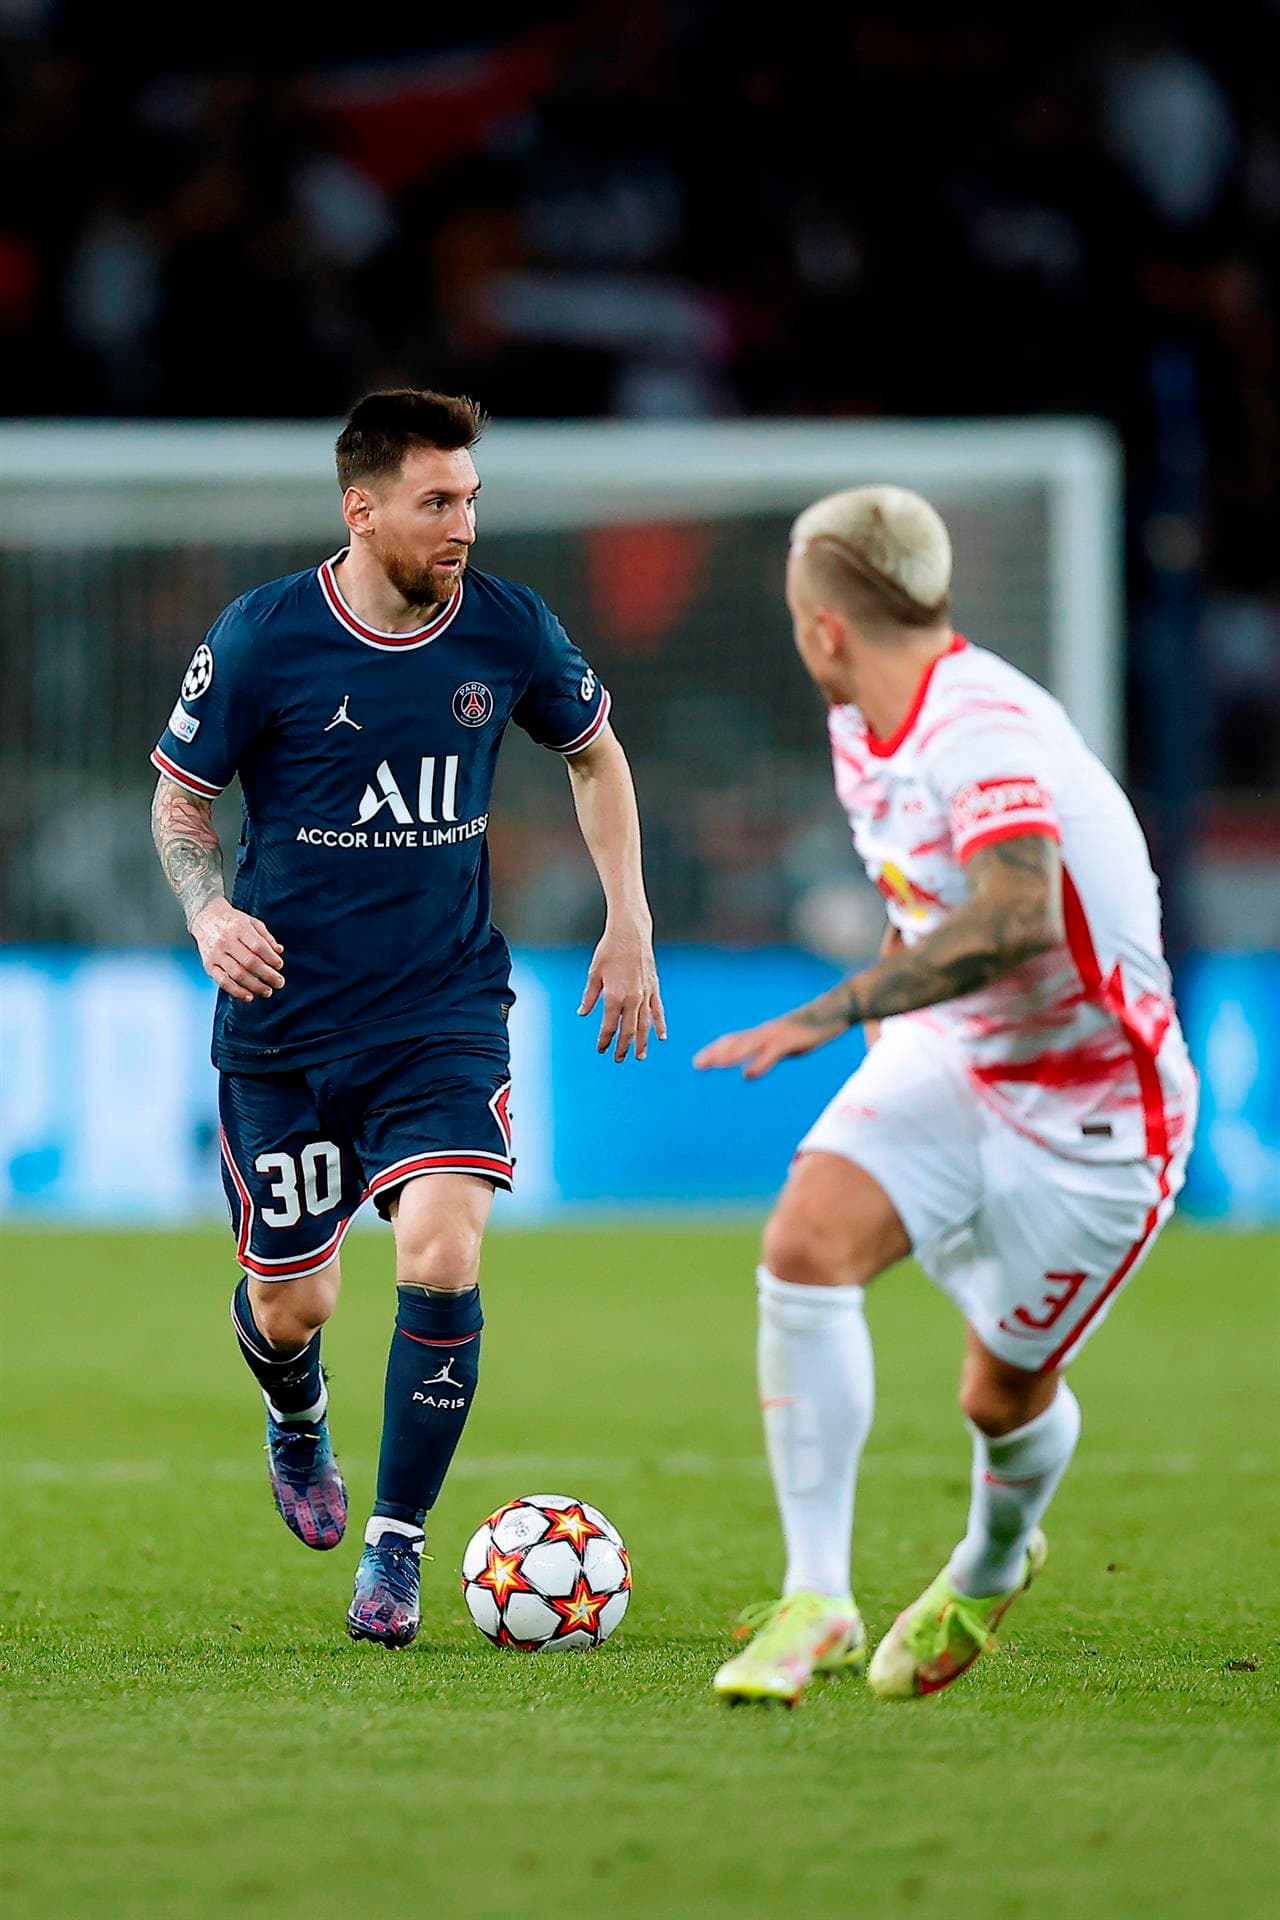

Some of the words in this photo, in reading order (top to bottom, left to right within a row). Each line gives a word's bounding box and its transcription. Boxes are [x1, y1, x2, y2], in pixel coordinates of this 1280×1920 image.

[459, 684, 487, 696] PARIS
[296, 826, 369, 849] ACCOR
[373, 830, 418, 848] LIVE
[254, 1140, 342, 1228] 30
[1013, 1269, 1088, 1331] 3
[412, 1391, 466, 1410] PARIS
